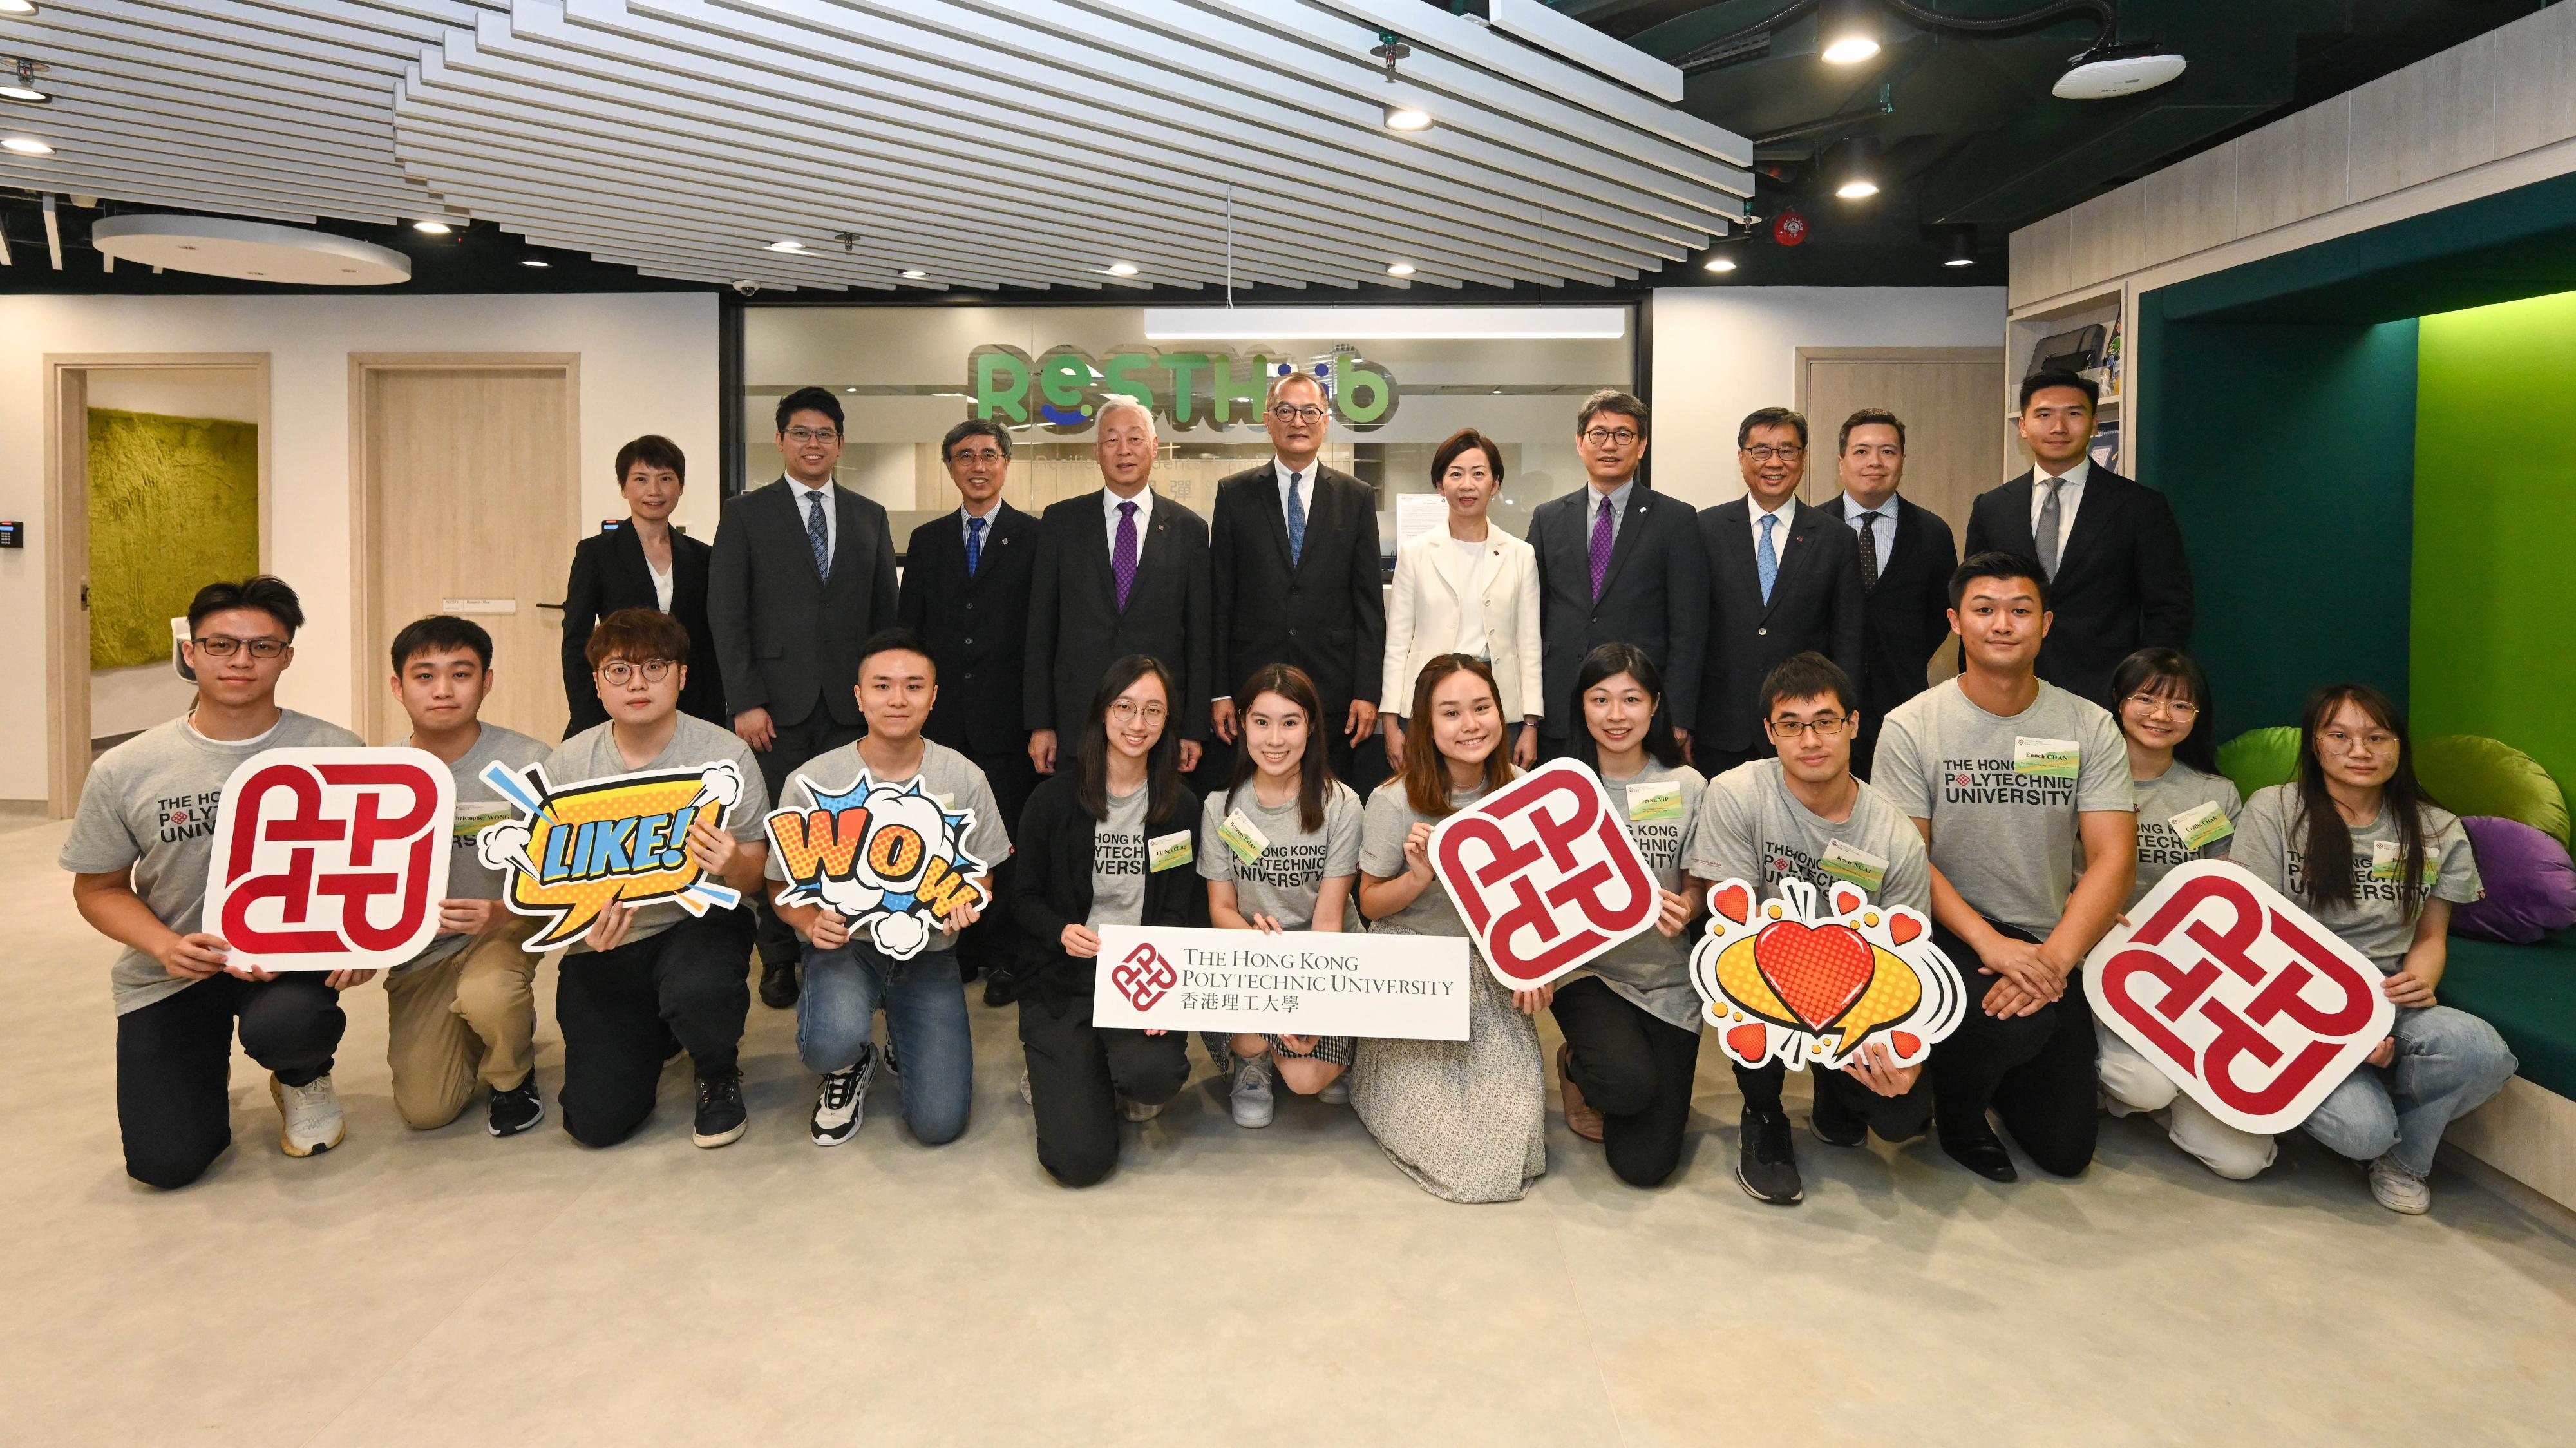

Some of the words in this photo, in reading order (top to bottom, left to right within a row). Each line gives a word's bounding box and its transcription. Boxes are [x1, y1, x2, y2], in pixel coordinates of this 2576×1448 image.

[1943, 759, 1976, 771] THE
[158, 795, 192, 811] THE
[198, 791, 222, 805] HO
[1946, 788, 2072, 806] UNIVERSITY
[2137, 823, 2163, 834] NG
[2202, 816, 2218, 826] CHAN
[1230, 821, 1244, 839] Brittany
[1244, 836, 1258, 851] CHAU
[1638, 825, 1678, 837] KONG
[542, 807, 699, 883] LIKE!
[1262, 846, 1288, 857] ONG
[1290, 845, 1326, 856] KONG
[770, 808, 980, 918] WOW
[1837, 855, 1853, 866] Karis
[1854, 862, 1871, 873] NGAI
[2352, 859, 2372, 868] NG
[1182, 948, 1226, 967] THE
[1231, 950, 1294, 969] HONG
[1300, 951, 1359, 972] KONG
[1182, 969, 1327, 992] POLYTECHNIC
[1331, 975, 1454, 996] UNIVERSITY
[1180, 992, 1300, 1013] 香港理工大學
